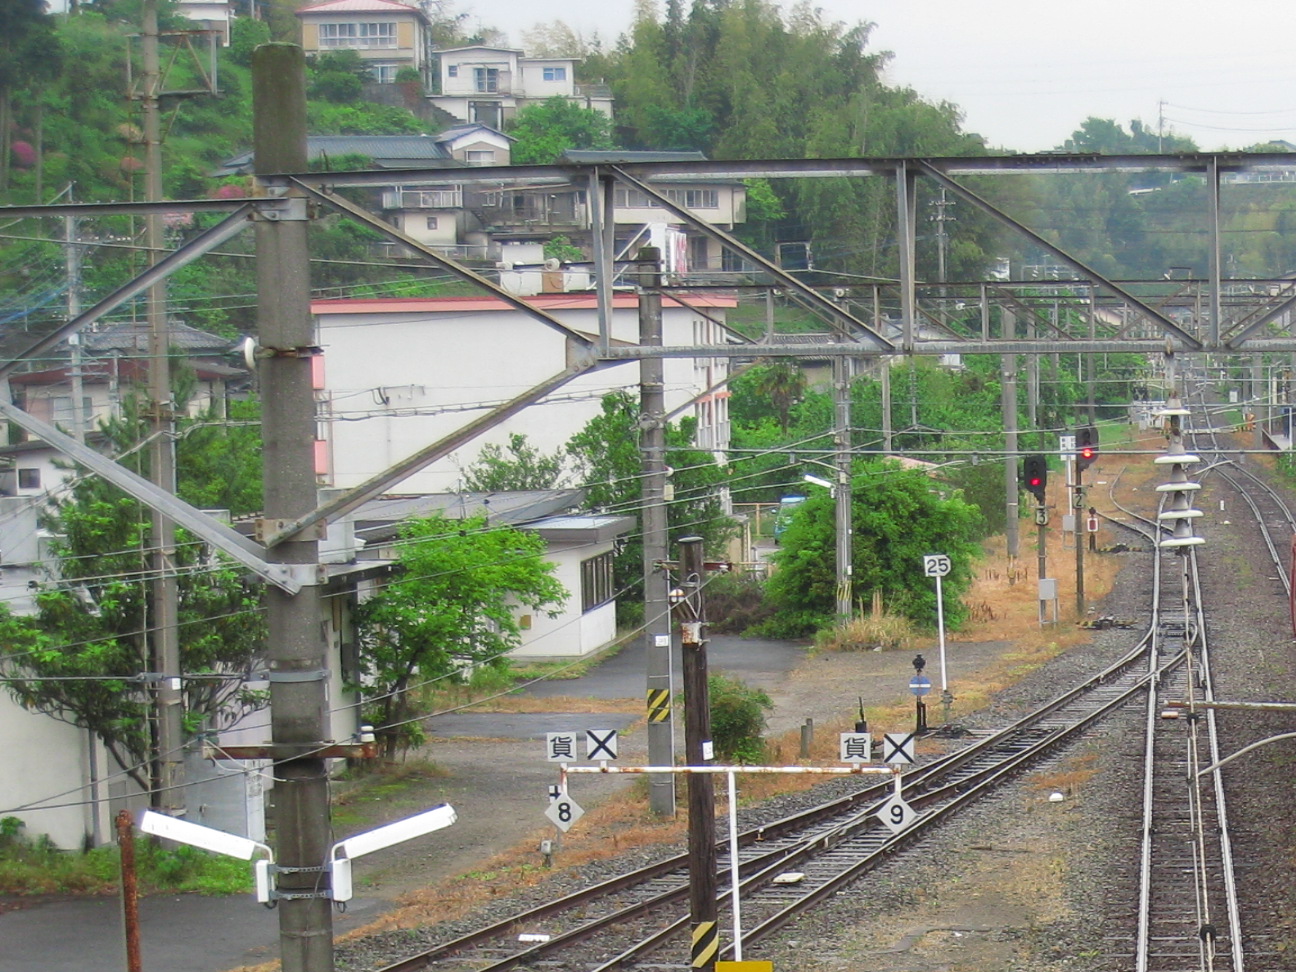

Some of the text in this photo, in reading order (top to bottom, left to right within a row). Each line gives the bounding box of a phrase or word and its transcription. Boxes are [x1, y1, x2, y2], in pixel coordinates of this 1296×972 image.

[1039, 511, 1046, 524] 3
[927, 558, 949, 573] 25
[550, 736, 574, 758] 貨
[844, 737, 867, 760] 貨
[558, 802, 572, 822] 8
[890, 804, 904, 825] 9
